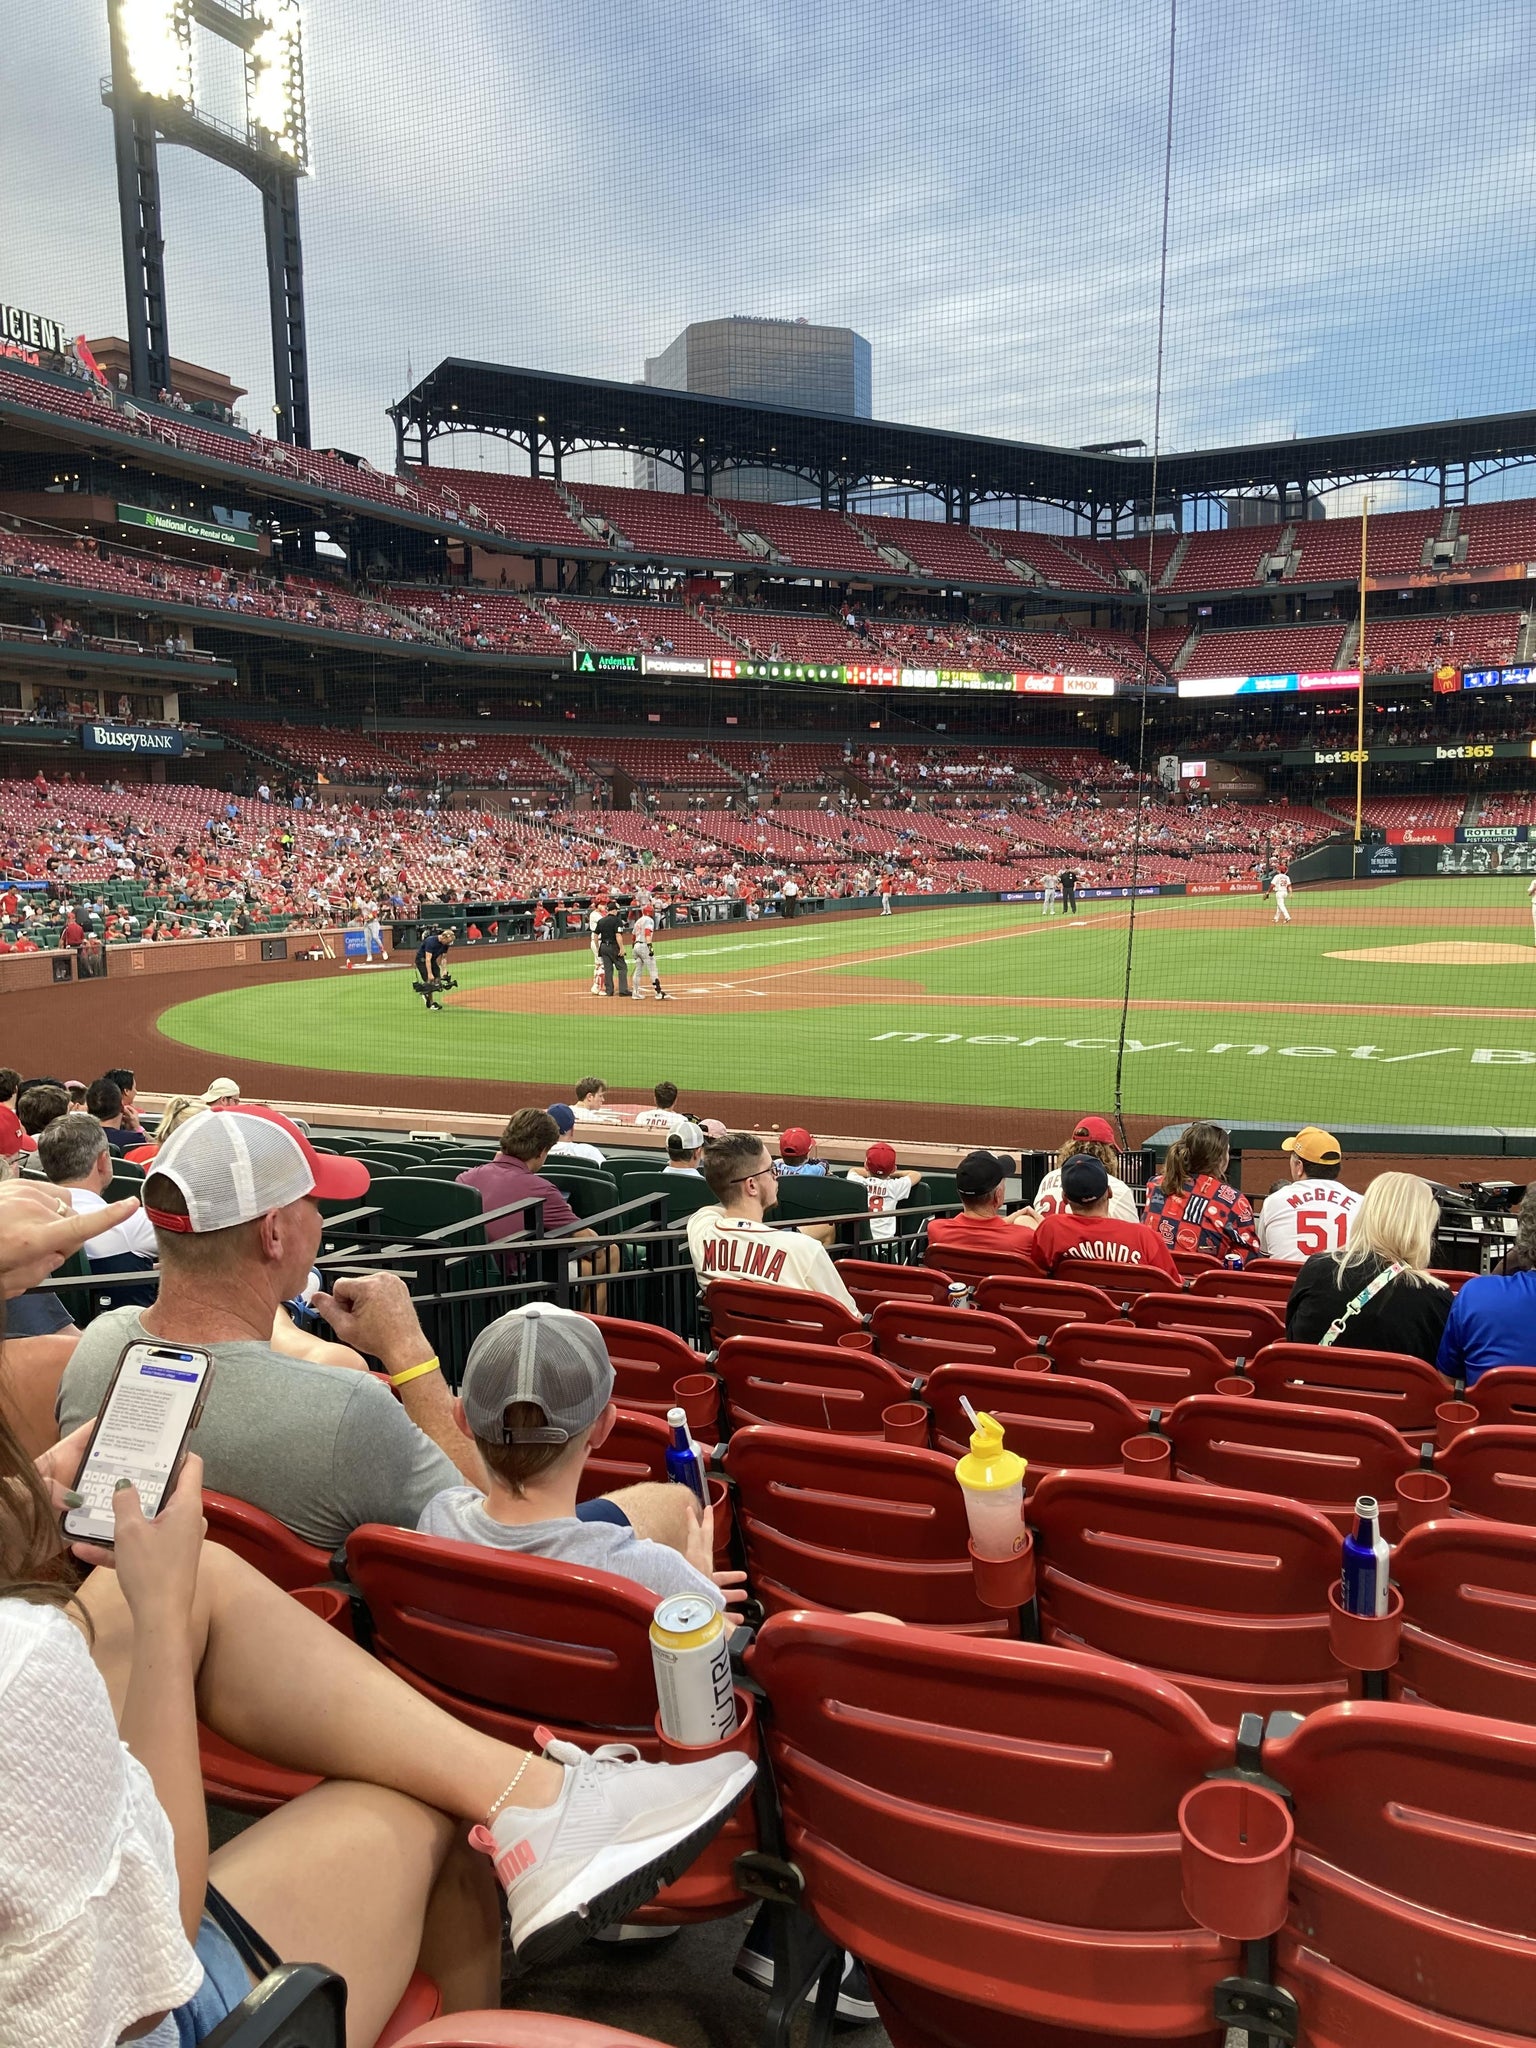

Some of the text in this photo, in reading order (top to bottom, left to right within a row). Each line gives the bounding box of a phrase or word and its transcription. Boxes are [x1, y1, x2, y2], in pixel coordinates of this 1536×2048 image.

[1, 304, 65, 354] ICIENT
[188, 525, 199, 535] Car
[200, 528, 221, 539] Rental
[221, 533, 235, 543] Club
[599, 655, 636, 666] Ardent IT
[1067, 681, 1098, 691] KMOX
[1315, 751, 1369, 764] bet365
[1436, 745, 1494, 759] bet365
[1466, 828, 1515, 836] ROTTLER
[1296, 1210, 1348, 1256] 51
[702, 1238, 787, 1282] MOLINA
[1062, 1240, 1142, 1265] DMONDS
